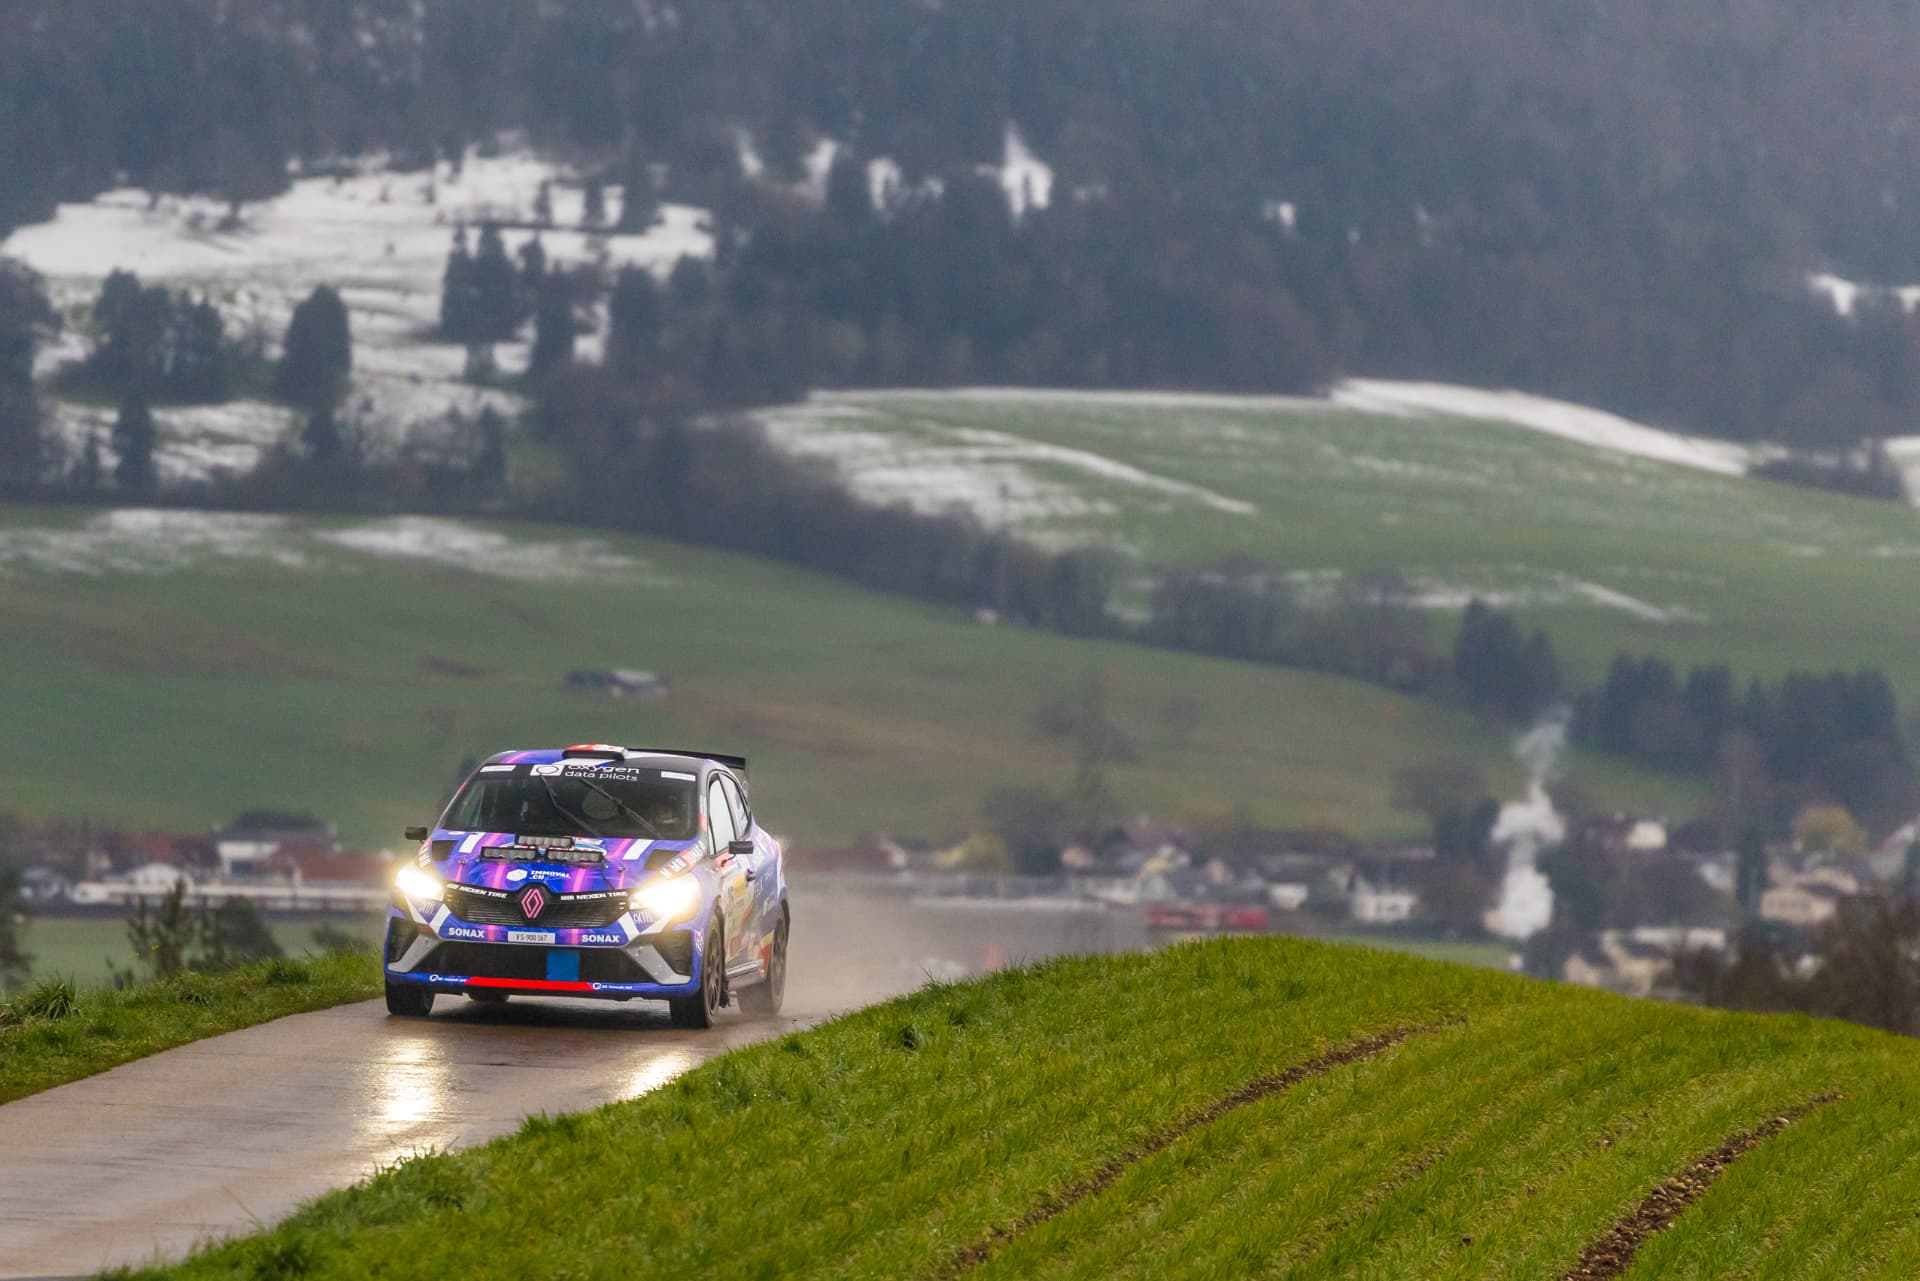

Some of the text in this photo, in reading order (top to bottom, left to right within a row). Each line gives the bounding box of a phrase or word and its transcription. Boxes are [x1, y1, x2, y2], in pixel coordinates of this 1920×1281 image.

[567, 764, 640, 774] oxygen
[599, 773, 638, 781] pilots
[487, 891, 508, 899] TIRE
[448, 927, 485, 939] SONAX
[581, 934, 620, 943] SONAX
